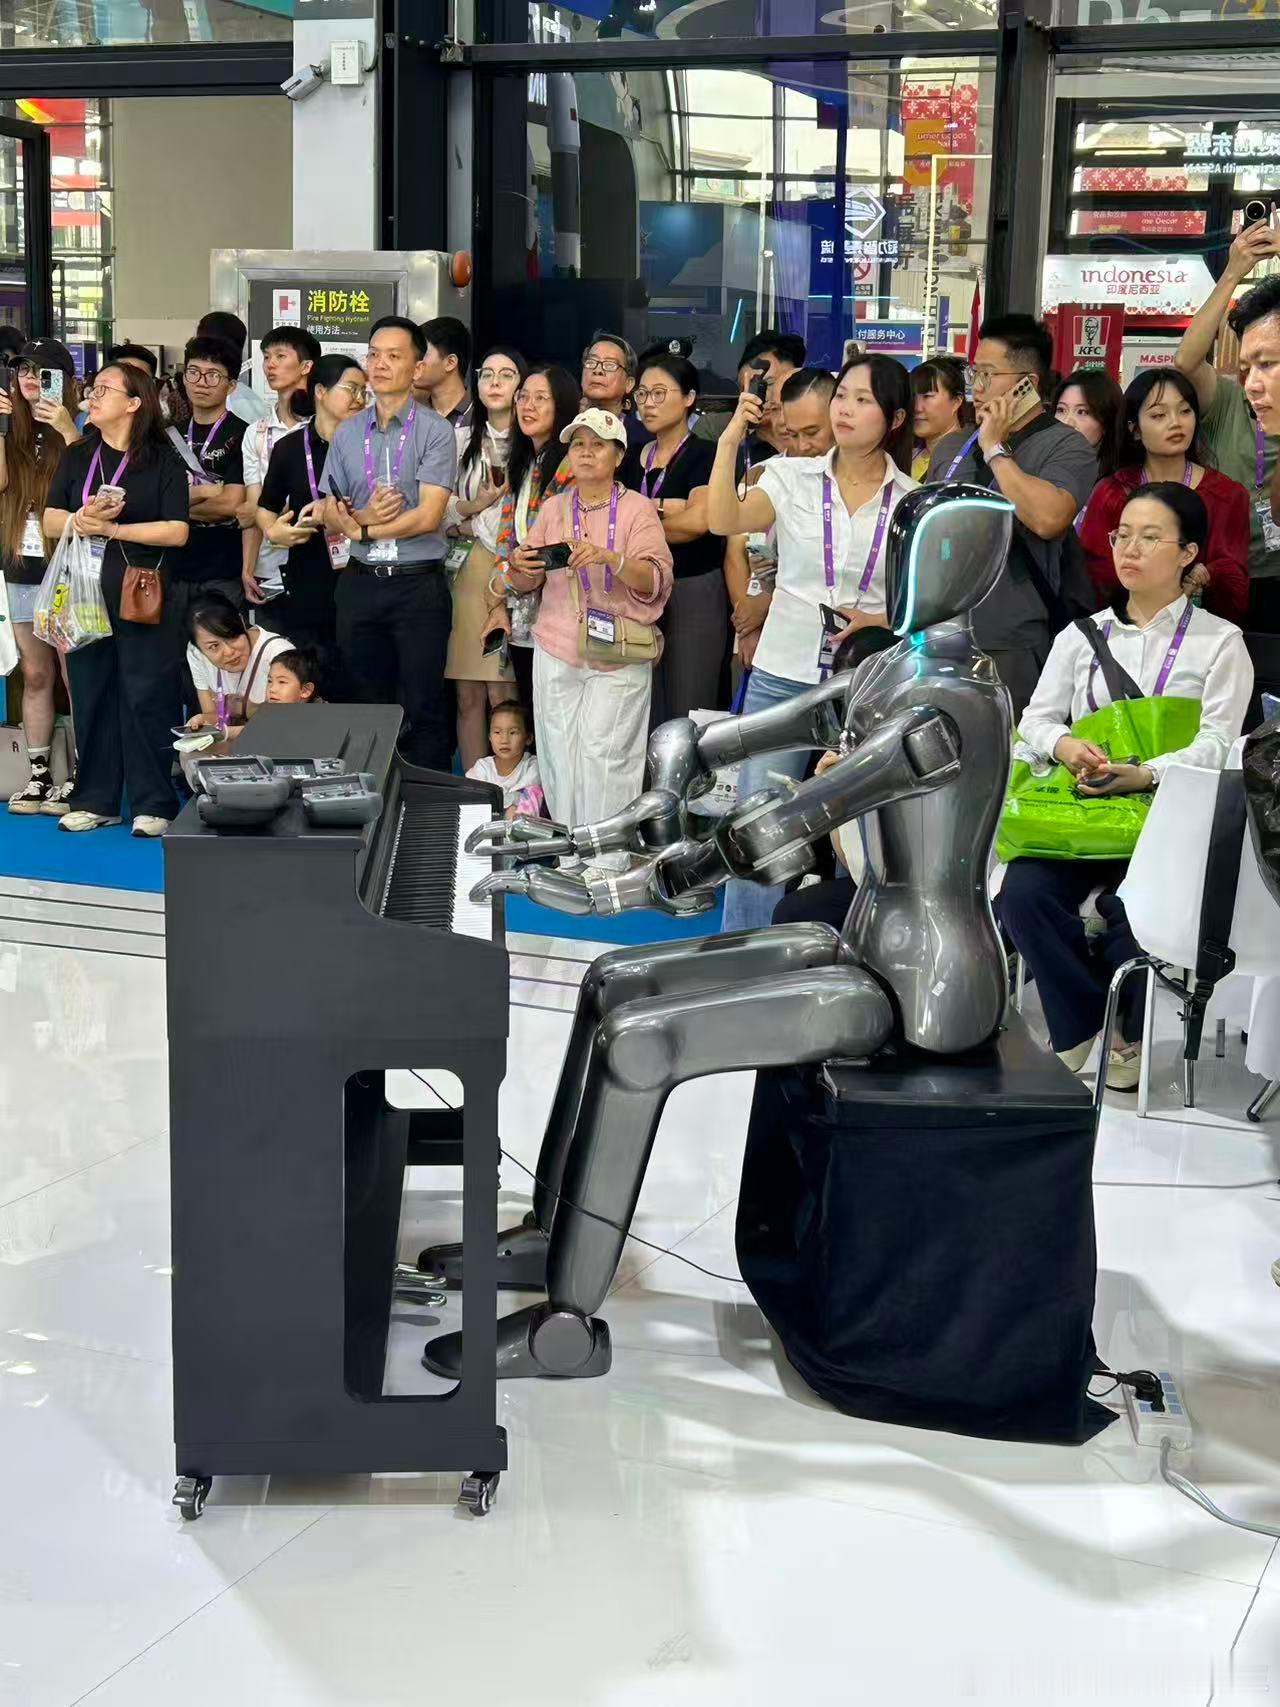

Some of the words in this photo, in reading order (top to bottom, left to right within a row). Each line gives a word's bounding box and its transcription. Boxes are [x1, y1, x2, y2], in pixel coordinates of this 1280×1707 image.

[1081, 265, 1188, 283] indonesia
[1106, 284, 1161, 295] 印度尼西亚
[307, 290, 370, 313] 消防栓
[307, 324, 341, 335] 使用方法
[855, 329, 906, 341] 付服务中心
[1078, 346, 1102, 355] KFC
[1139, 354, 1176, 364] MASPI
